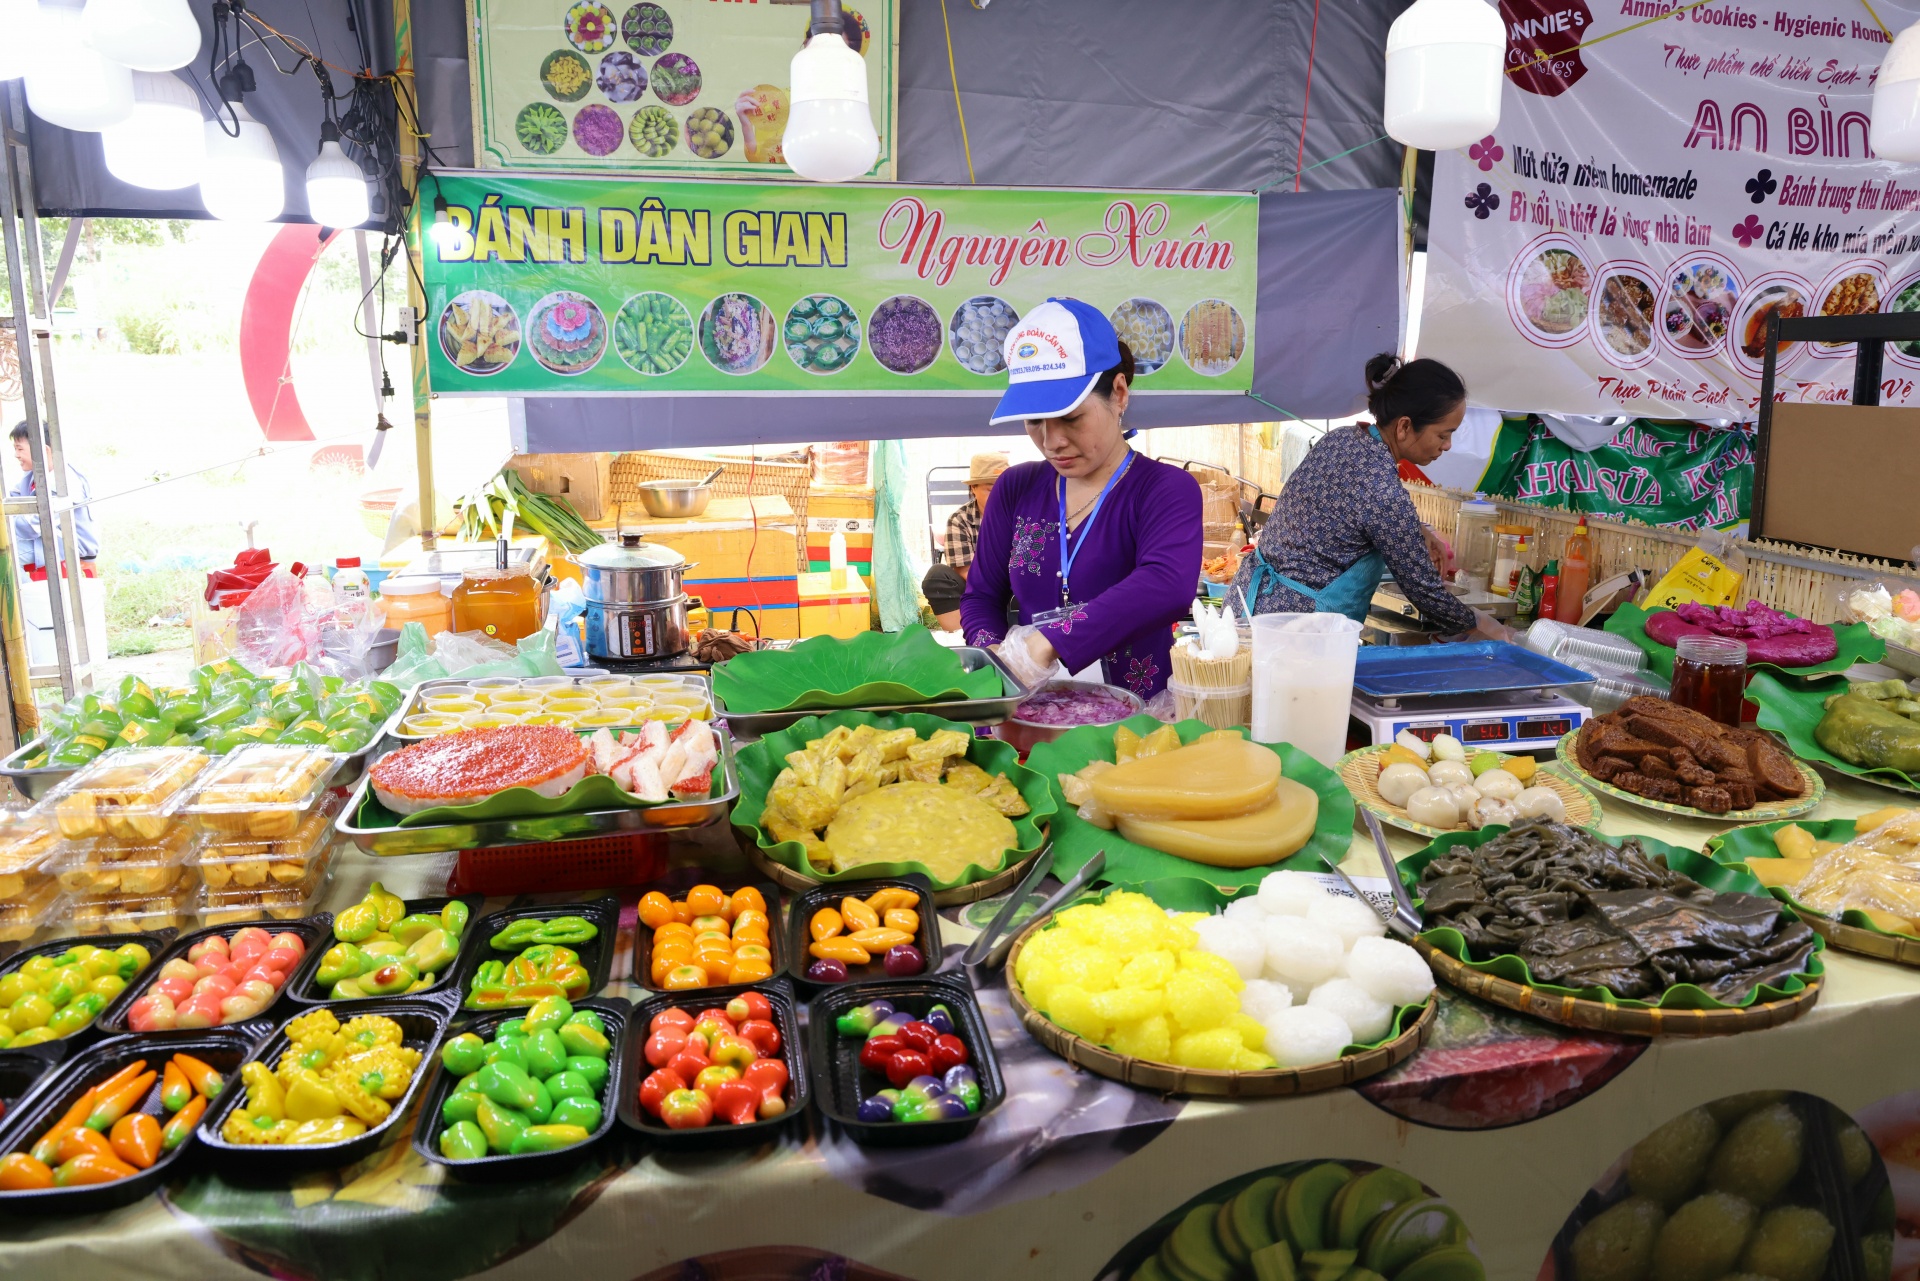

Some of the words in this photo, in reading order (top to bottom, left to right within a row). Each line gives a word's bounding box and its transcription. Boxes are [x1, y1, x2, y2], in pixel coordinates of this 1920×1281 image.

[1620, 0, 1686, 21] Annie's
[1692, 4, 1757, 29] Cookies
[1774, 11, 1846, 38] Hygienic
[1663, 43, 1701, 76] Thực
[1703, 48, 1745, 80] phẩm
[1750, 54, 1778, 78] chế
[1778, 56, 1812, 83] biến
[1683, 99, 1767, 153] AN
[1513, 144, 1538, 179] Mứt
[1540, 152, 1570, 185] dừa
[1573, 155, 1610, 191] mềm
[1612, 164, 1698, 200] homemade
[1778, 175, 1816, 207] Bánh
[1818, 178, 1857, 215] trung
[1857, 179, 1881, 210] thu
[437, 193, 586, 265] BÁNH
[600, 197, 711, 267] DÂN
[724, 209, 848, 268] GIAN
[1509, 190, 1527, 222] Bì
[1556, 200, 1568, 229] bì
[1570, 203, 1598, 241] thịt
[1599, 206, 1618, 236] lá
[1654, 214, 1680, 244] nhà
[1684, 215, 1712, 246] làm
[1765, 221, 1789, 250] Cá
[1788, 222, 1810, 251] He
[1811, 223, 1840, 253] kho
[1841, 226, 1868, 254] mía
[1872, 222, 1907, 255] mềm
[878, 196, 1072, 288] Nguyên
[1075, 200, 1237, 272] Xuân
[1598, 376, 1643, 405] Thực
[1647, 378, 1687, 402] Phẩm
[1692, 382, 1729, 409] Sạch
[1796, 380, 1850, 402] Toàn
[1880, 378, 1913, 404] Vệ
